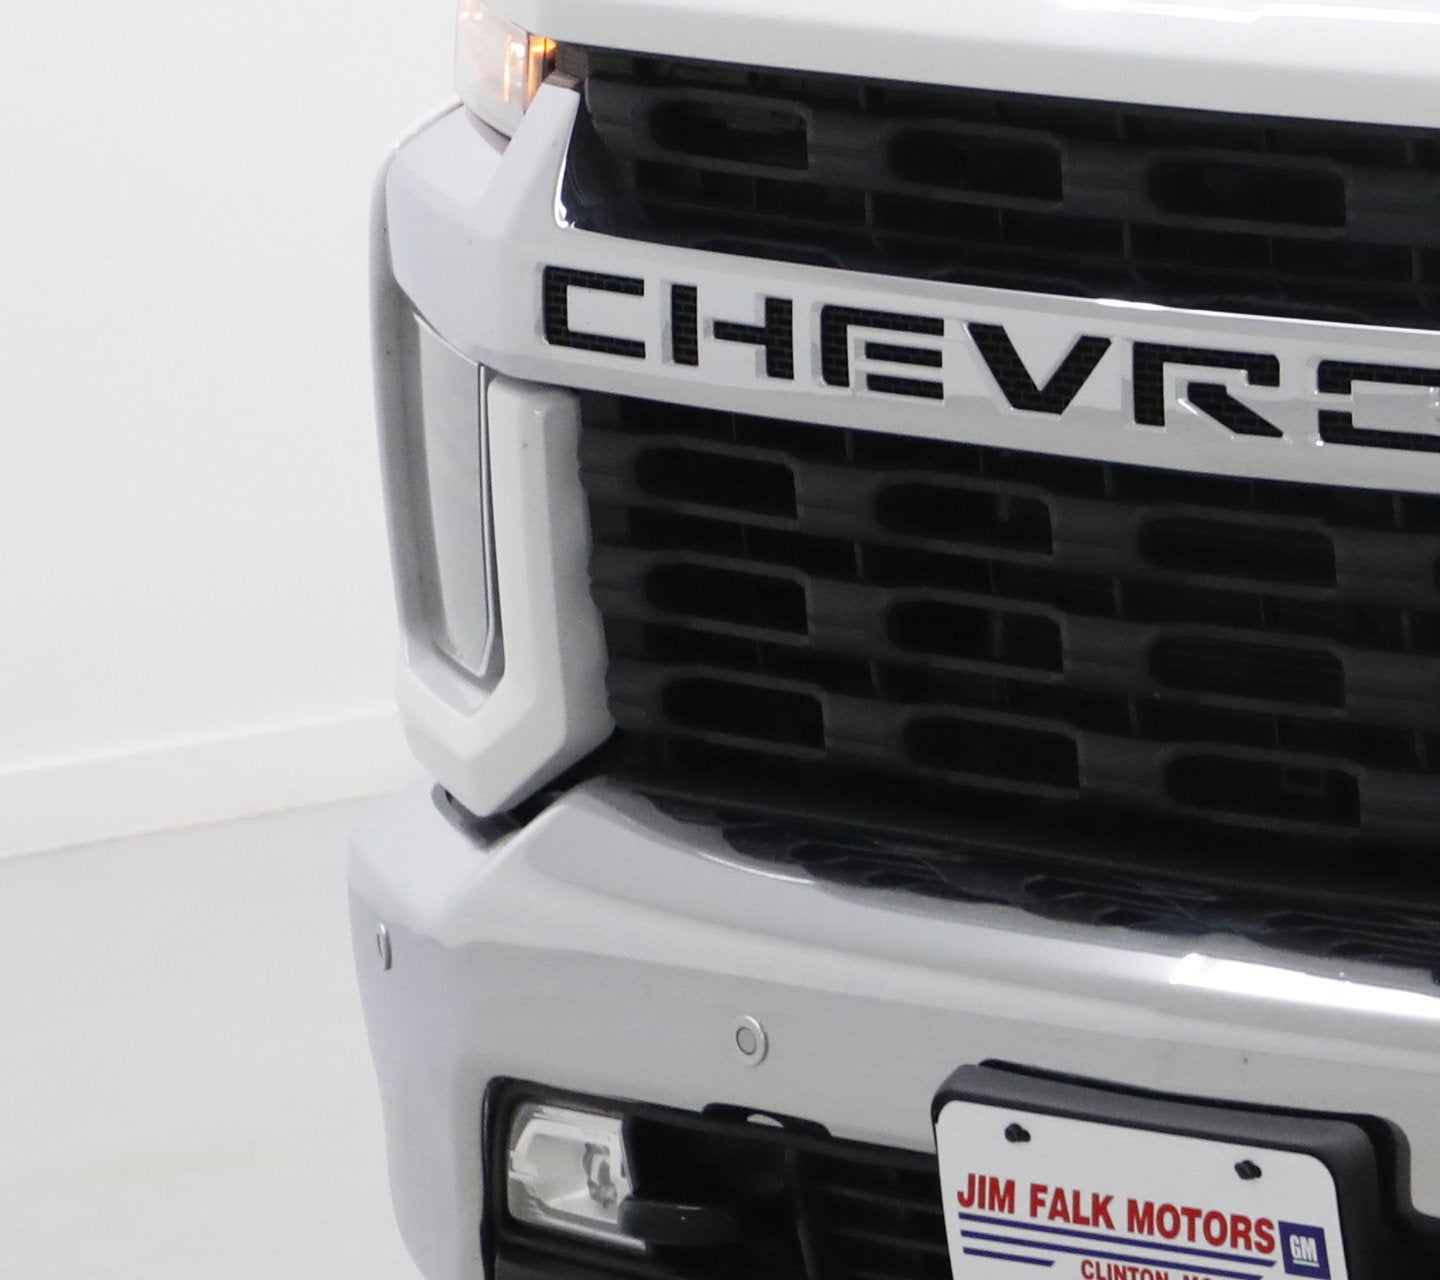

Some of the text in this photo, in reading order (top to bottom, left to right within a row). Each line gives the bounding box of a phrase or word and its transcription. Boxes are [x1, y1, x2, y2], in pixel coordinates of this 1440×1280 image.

[957, 1173, 1276, 1254] JIM FALK MOTORS
[1289, 1234, 1319, 1267] GM
